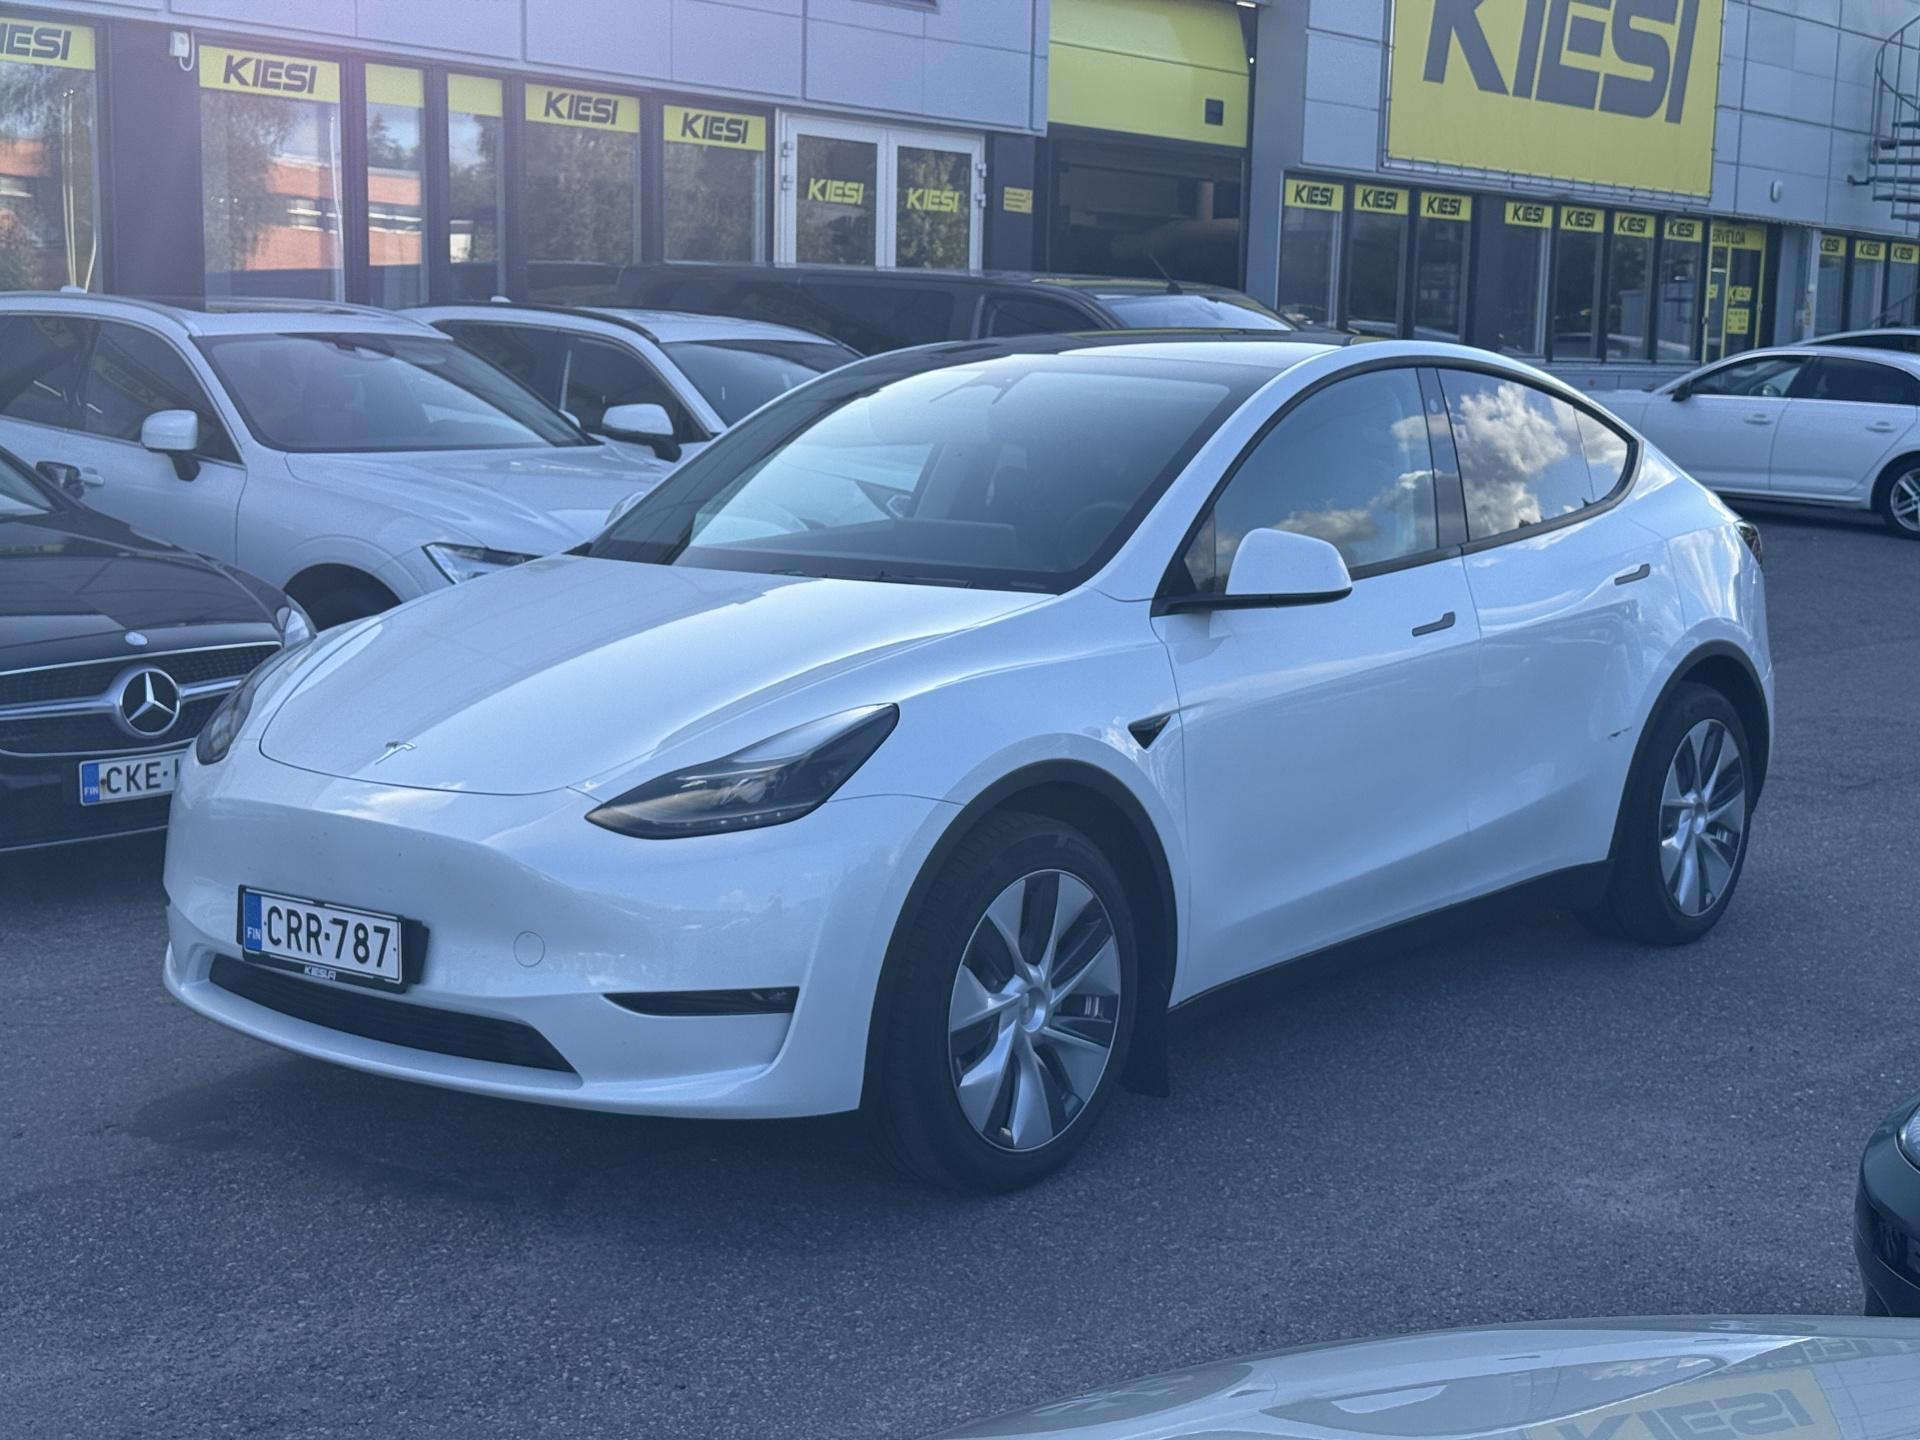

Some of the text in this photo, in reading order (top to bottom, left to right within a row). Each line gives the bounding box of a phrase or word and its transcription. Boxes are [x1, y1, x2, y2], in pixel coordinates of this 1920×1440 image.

[0, 23, 72, 60] IESI
[223, 54, 317, 94] KIESI
[1423, 0, 1699, 124] KIESI
[544, 91, 619, 126] KIESI
[681, 112, 749, 144] KIESI
[808, 178, 864, 205] KIESI
[907, 187, 960, 213] KIESI
[1294, 184, 1335, 207] KIESI
[1361, 191, 1399, 210] KIESI
[1426, 196, 1461, 216] KIESI
[1512, 204, 1545, 223] KIESI
[1565, 209, 1596, 228] KIESI
[1618, 215, 1646, 233] KIESI
[1668, 221, 1695, 238] KIESI
[106, 758, 180, 794] CKE-
[247, 926, 261, 940] FIN
[267, 905, 391, 968] CRR-787
